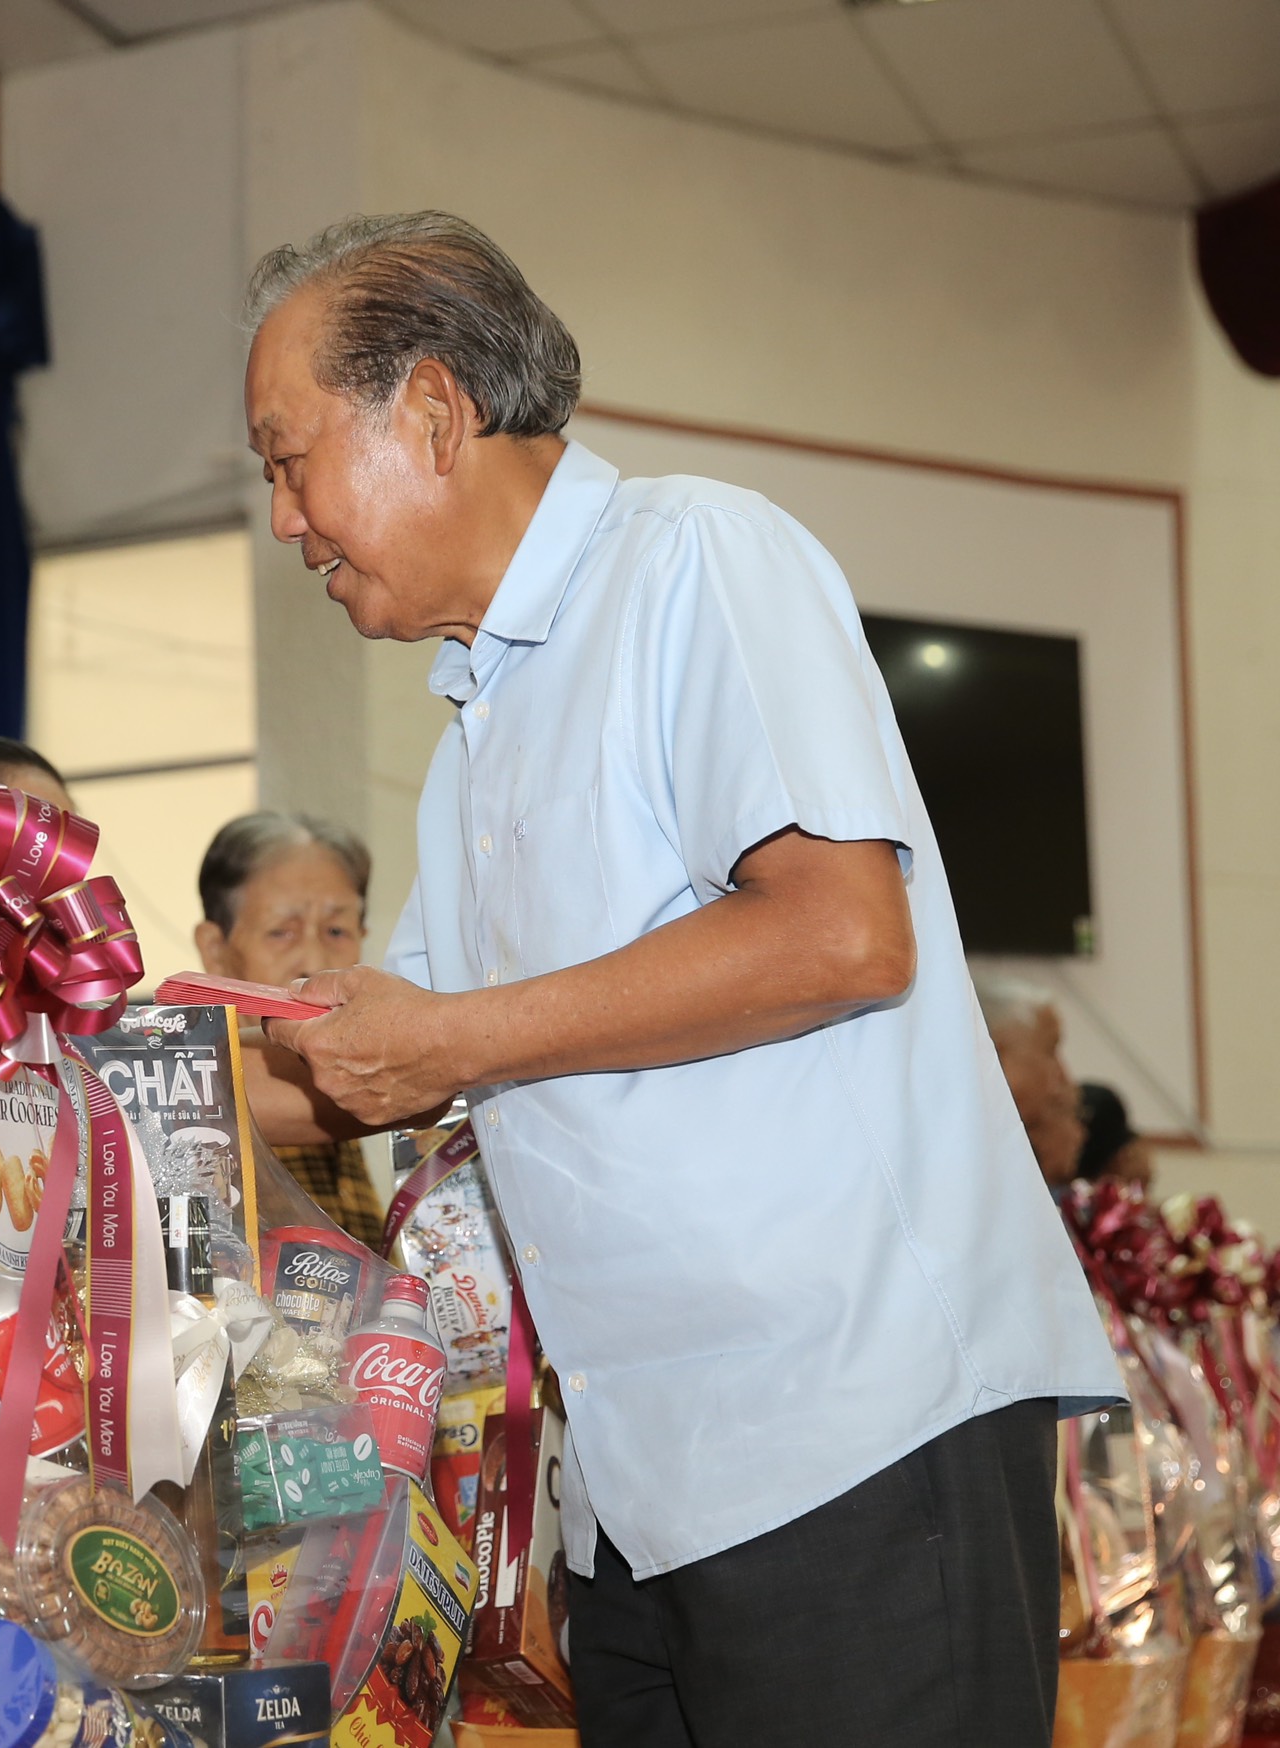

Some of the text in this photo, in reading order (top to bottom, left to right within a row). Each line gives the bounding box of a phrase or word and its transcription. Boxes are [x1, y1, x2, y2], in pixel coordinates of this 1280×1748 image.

[22, 831, 48, 866] Love
[4, 1080, 55, 1101] TRADITIONAL
[98, 1050, 218, 1107] CHẤT
[103, 1129, 119, 1248] I Love You More
[284, 1251, 351, 1285] Ritaz
[295, 1276, 338, 1293] GOLD
[276, 1290, 320, 1312] chocolate
[451, 1272, 488, 1329] Danisa
[100, 1343, 117, 1378] Love
[99, 1386, 115, 1413] You
[370, 1396, 437, 1425] ORIGINAL TA
[99, 1419, 115, 1457] More
[90, 1550, 159, 1601] BAZAN
[409, 1546, 438, 1598] DATES
[437, 1580, 466, 1632] FRUIT
[255, 1696, 302, 1722] ZELDA
[274, 1721, 285, 1730] TEA
